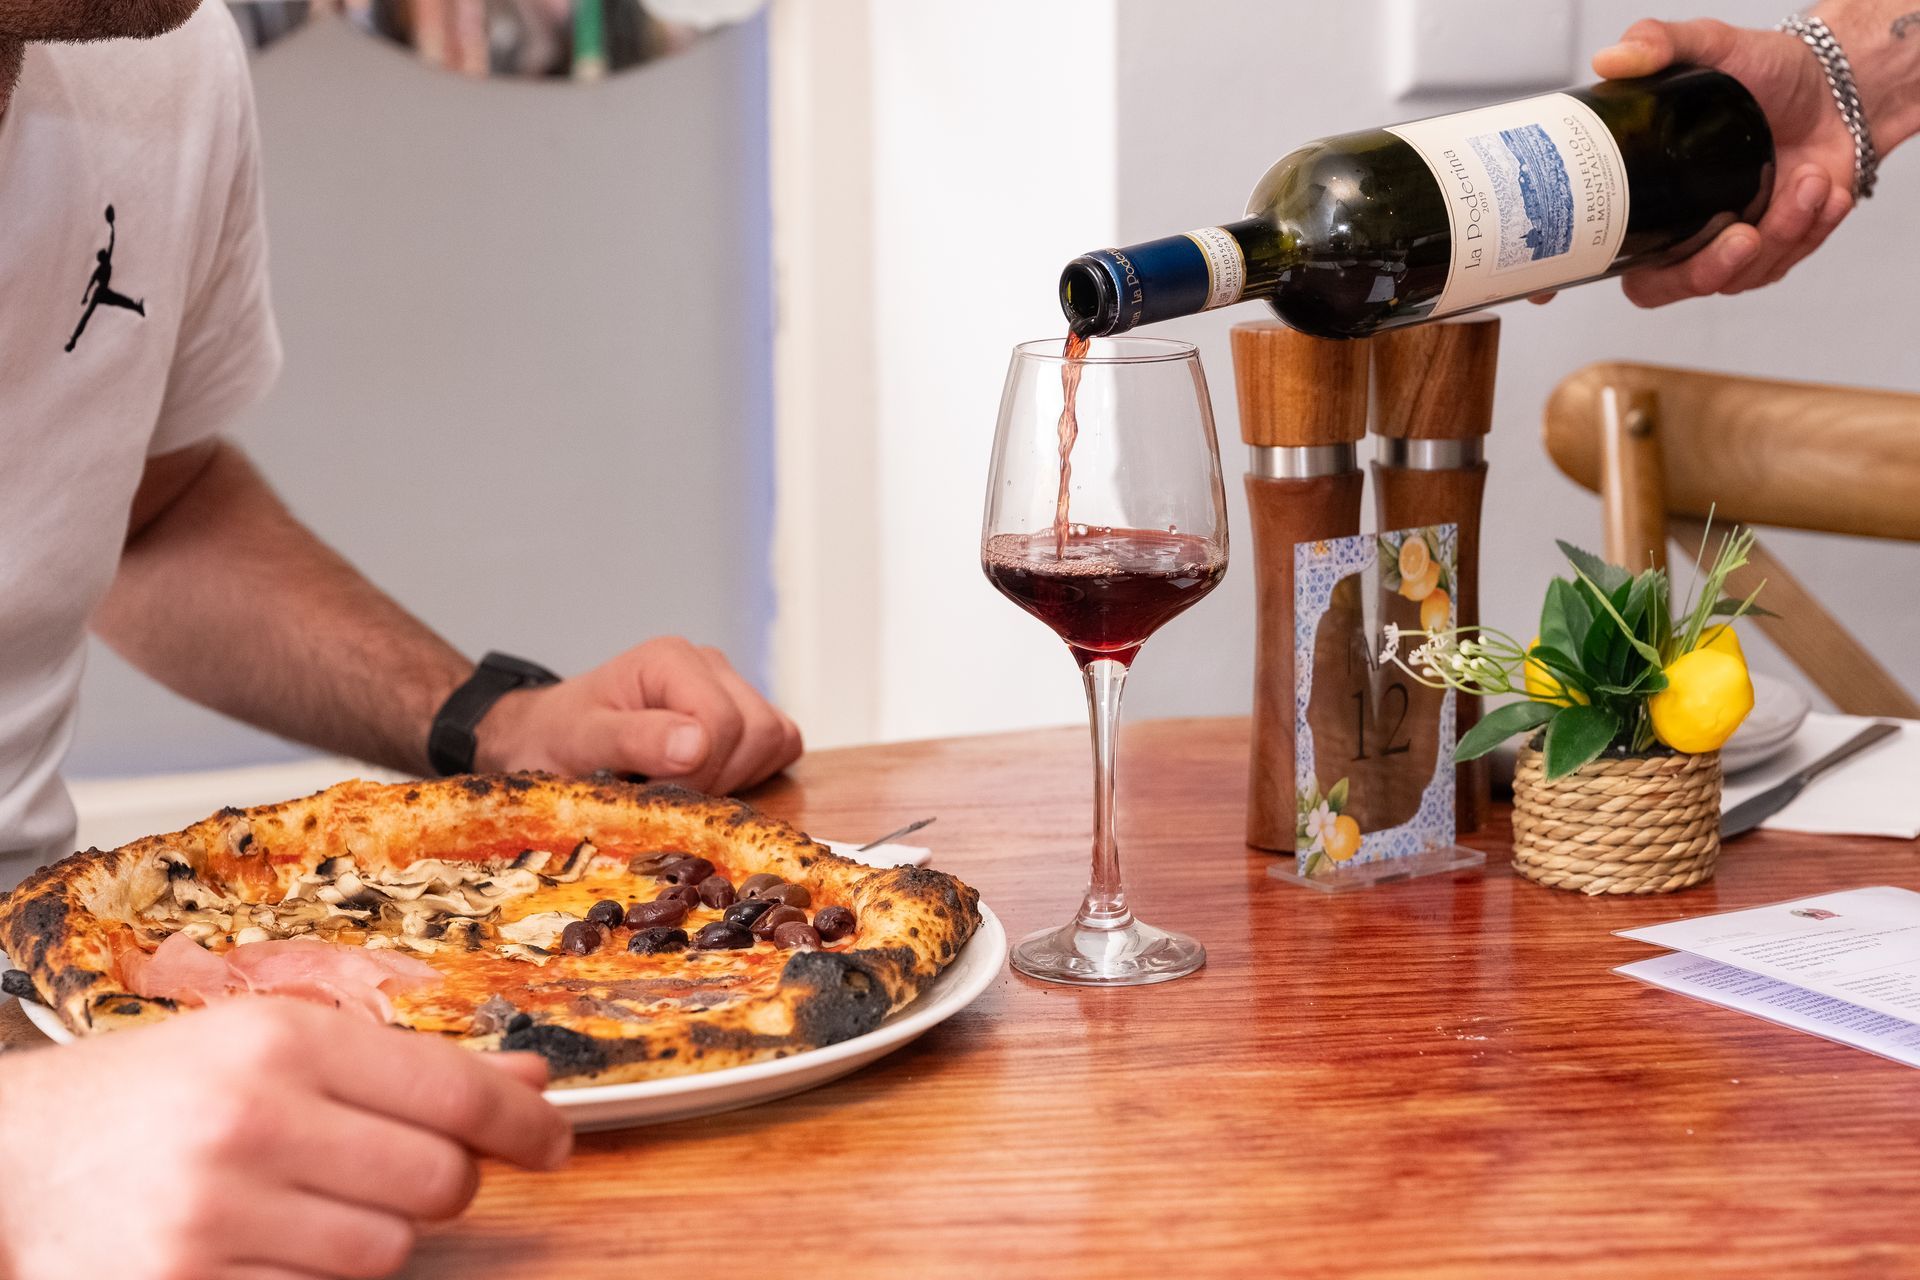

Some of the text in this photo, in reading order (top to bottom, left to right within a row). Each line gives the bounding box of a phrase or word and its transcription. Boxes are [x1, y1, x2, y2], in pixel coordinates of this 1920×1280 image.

[1443, 149, 1483, 270] La Poderina
[1478, 191, 1490, 214] 2019
[1563, 115, 1606, 246] DI MONTALCINO
[1569, 139, 1595, 223] BRUNELLO
[1131, 288, 1143, 305] La
[1350, 682, 1412, 761] 12
